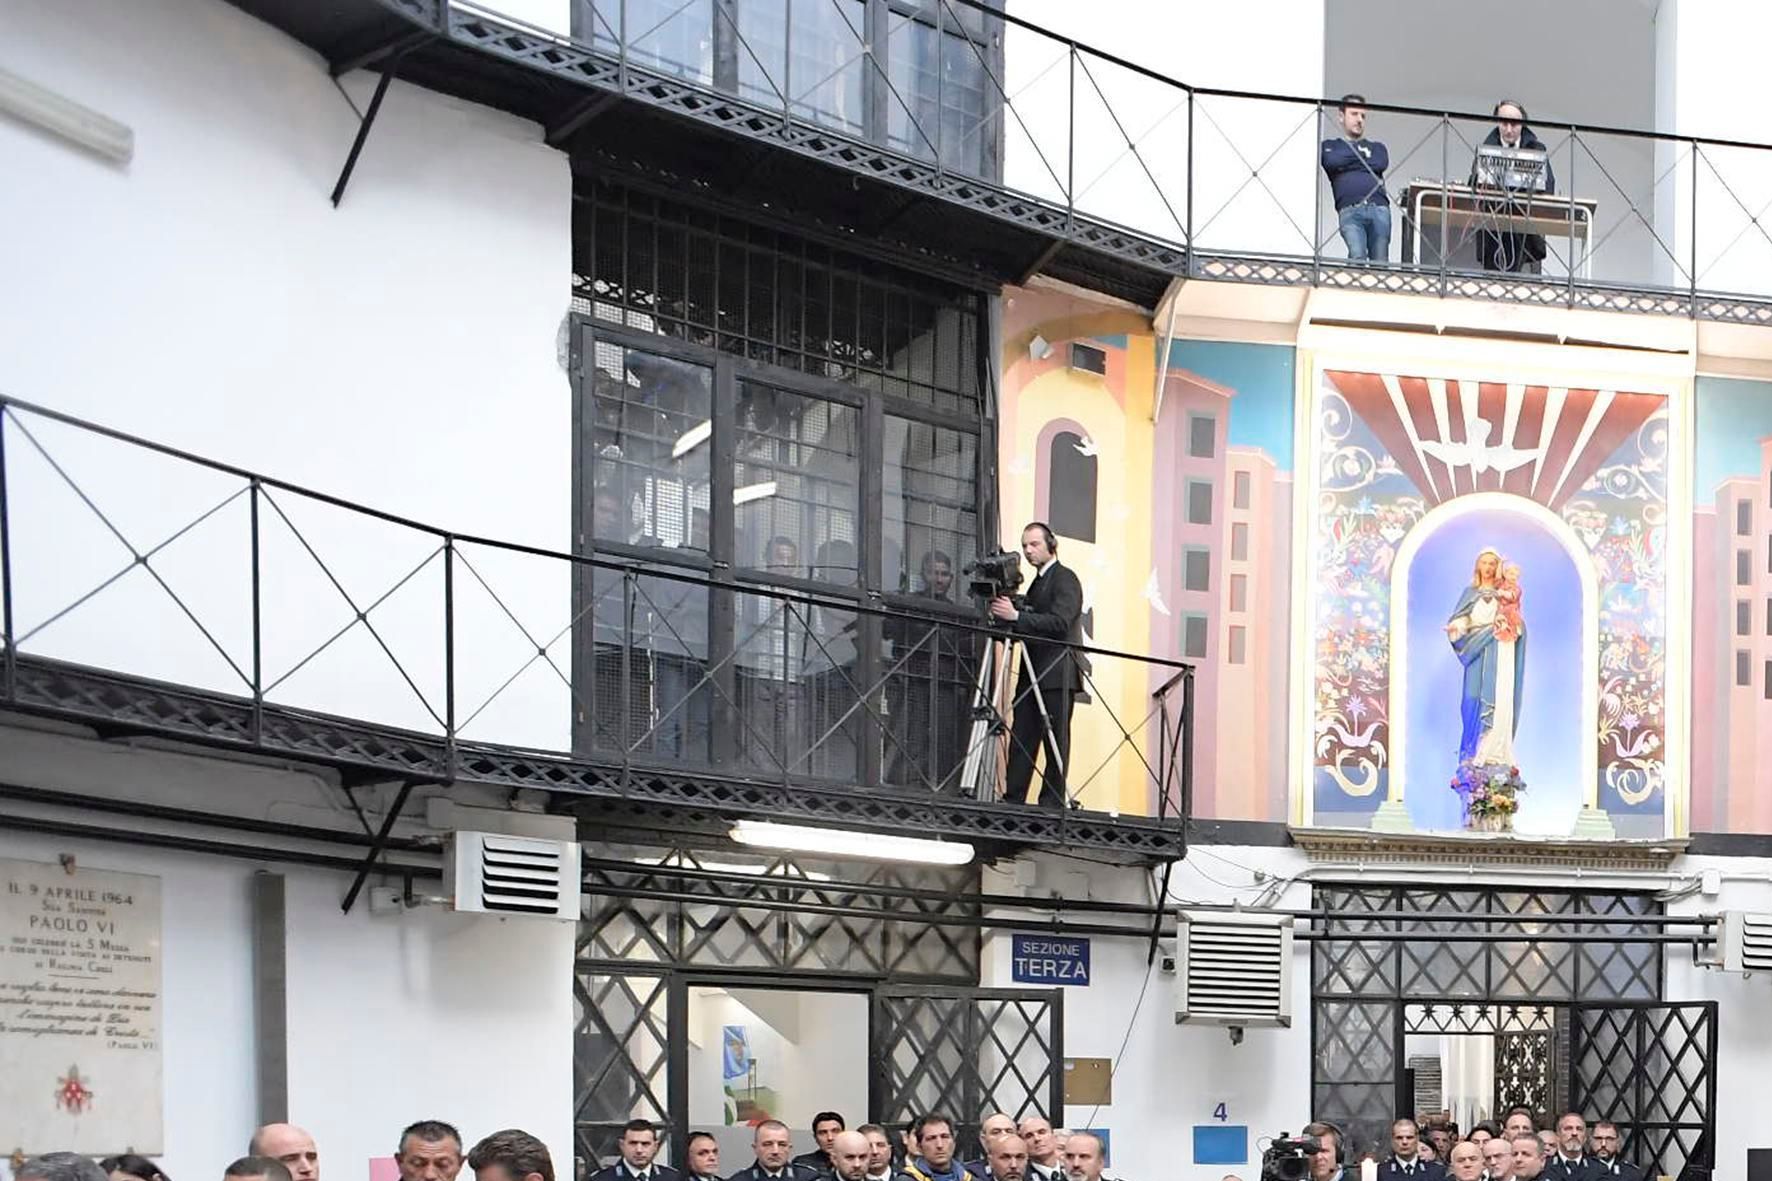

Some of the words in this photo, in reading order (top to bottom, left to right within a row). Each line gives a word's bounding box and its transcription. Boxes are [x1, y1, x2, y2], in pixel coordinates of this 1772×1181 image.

[45, 887, 96, 902] APRILE
[102, 892, 133, 905] 1964
[30, 915, 89, 933] PAOLO
[97, 921, 115, 936] VI
[1022, 942, 1080, 956] SEZIONE
[1014, 958, 1088, 979] TERZA
[1213, 1102, 1228, 1122] 4
